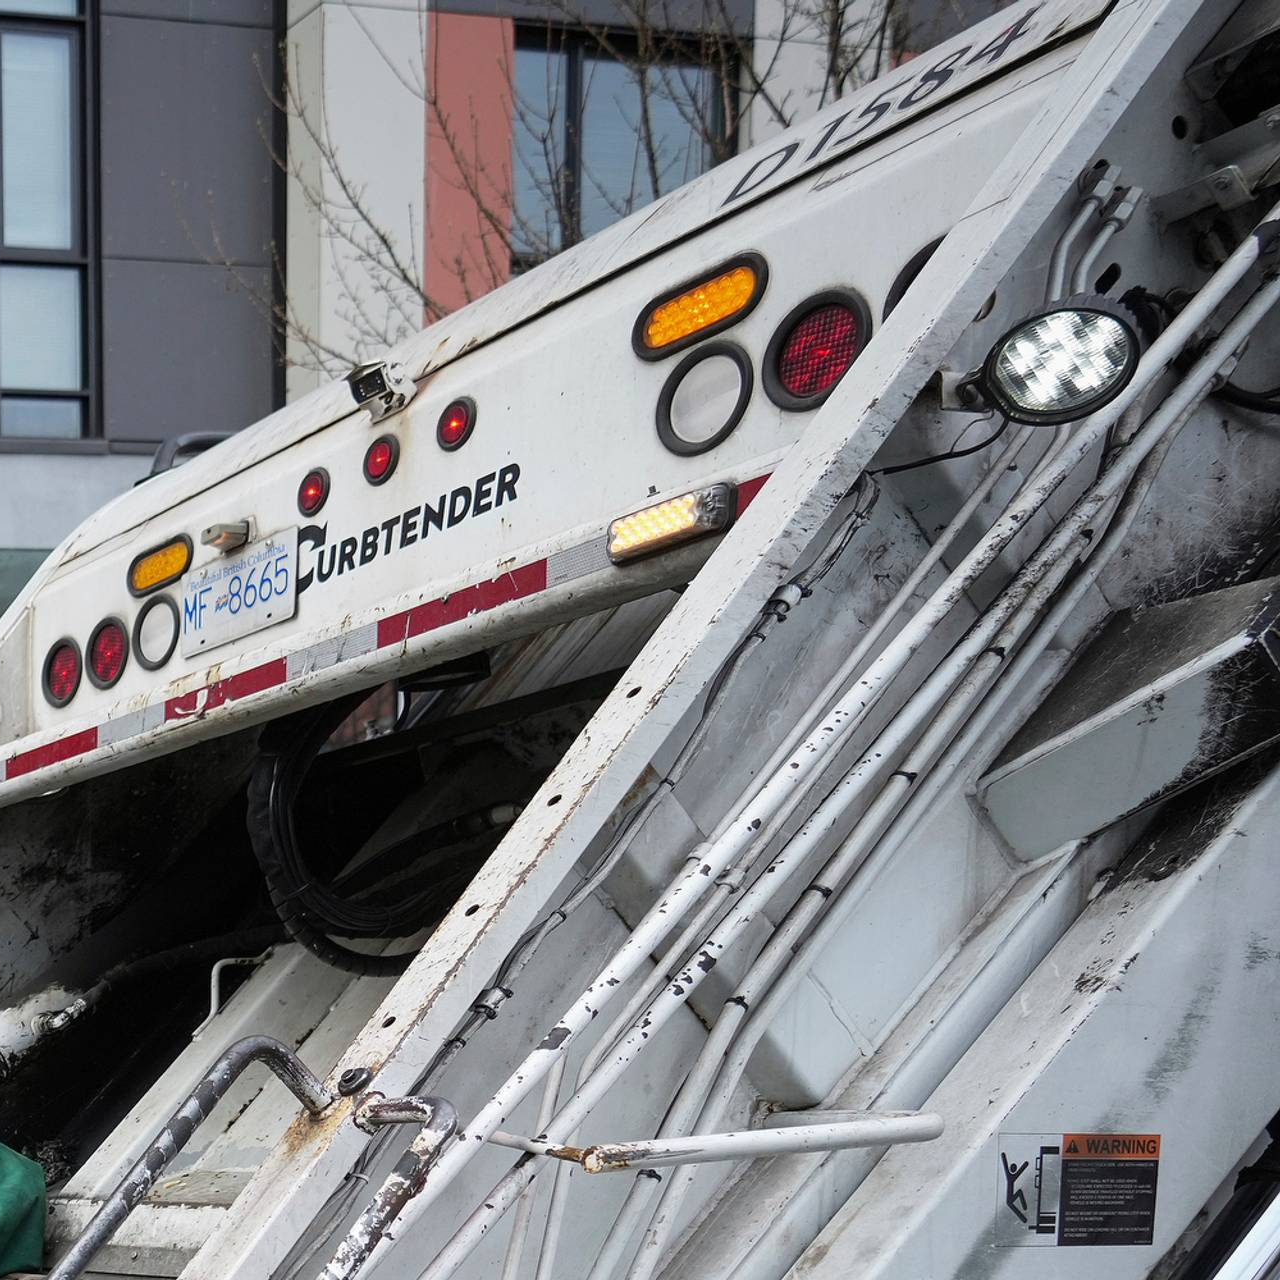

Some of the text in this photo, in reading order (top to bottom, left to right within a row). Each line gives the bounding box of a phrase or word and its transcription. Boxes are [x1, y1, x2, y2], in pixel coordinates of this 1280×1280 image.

[297, 463, 521, 595] CURBTENDER
[223, 559, 247, 578] British
[247, 544, 286, 567] Columbia
[184, 553, 289, 635] MF 8665
[1086, 1139, 1158, 1155] WARNING
